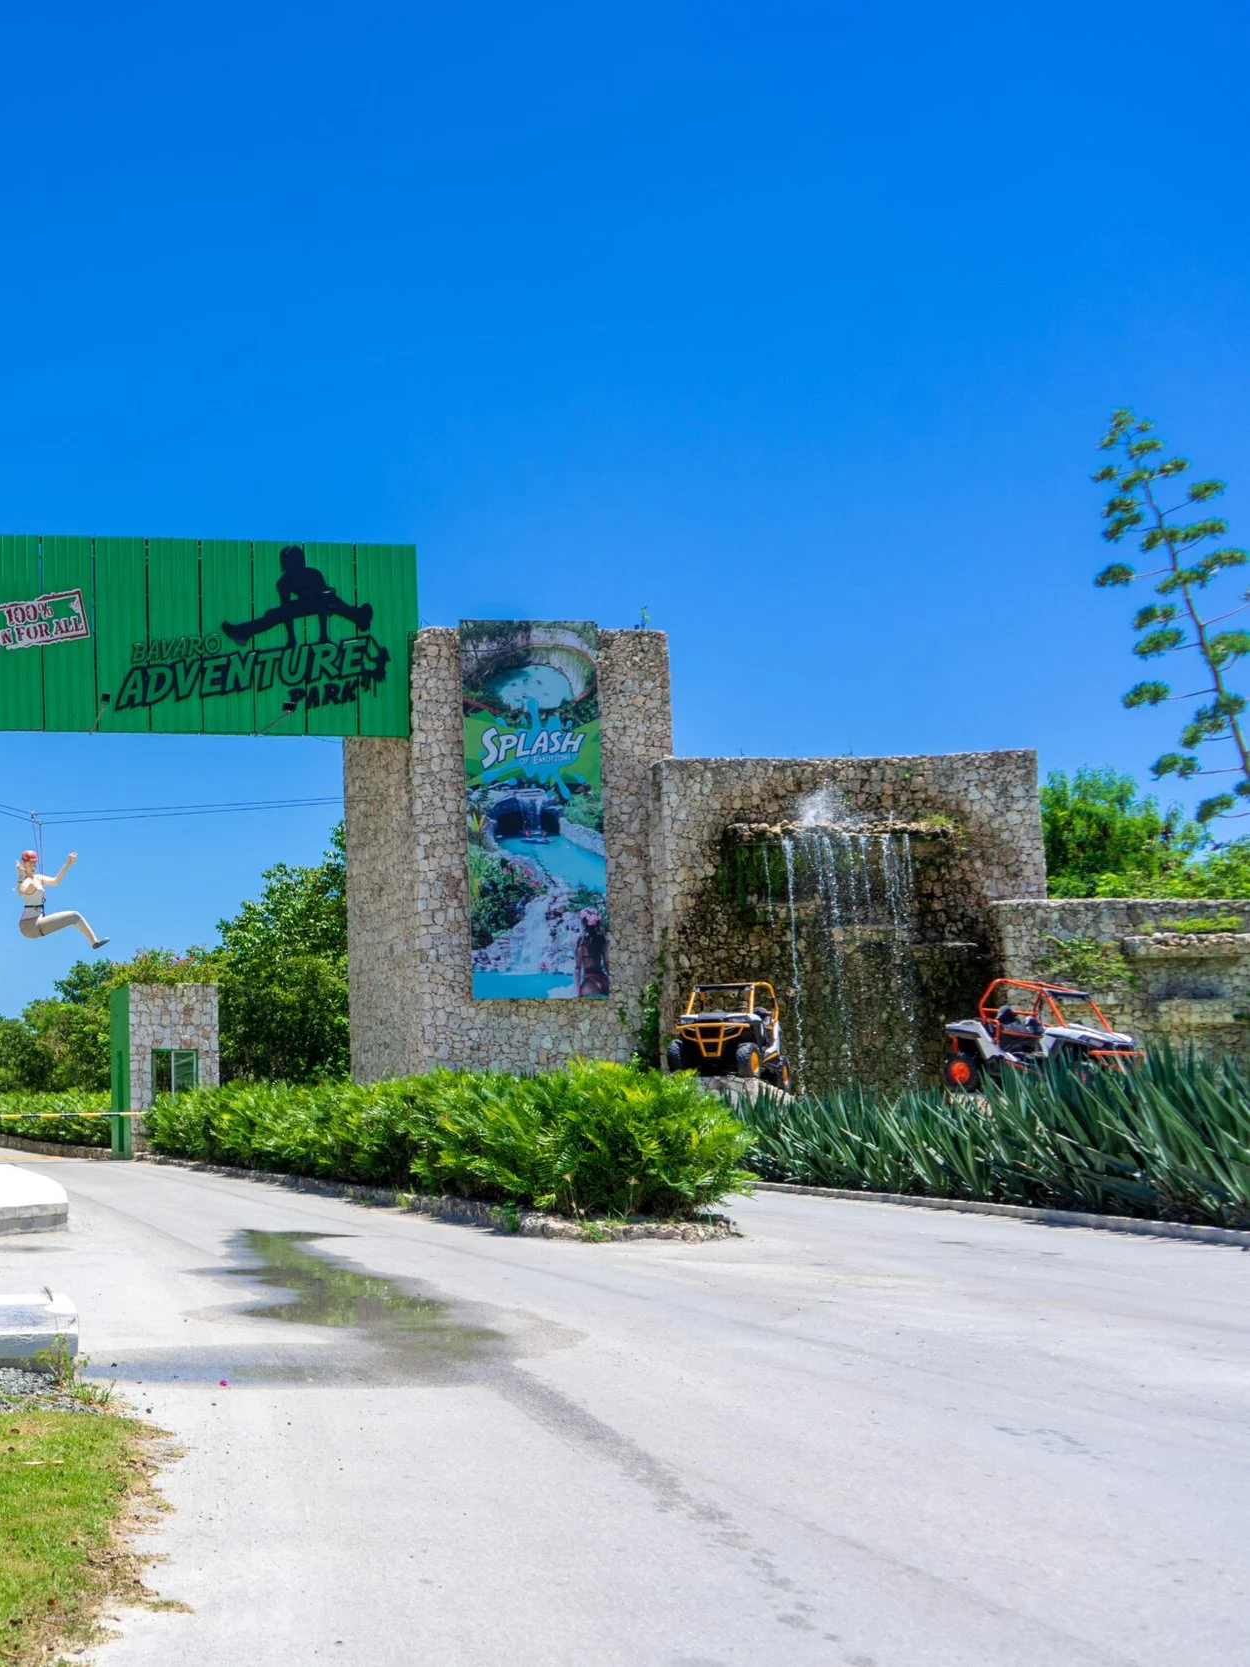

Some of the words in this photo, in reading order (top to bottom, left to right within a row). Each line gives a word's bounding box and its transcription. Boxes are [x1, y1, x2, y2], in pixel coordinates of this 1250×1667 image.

[6, 602, 54, 626] 100%
[15, 622, 50, 642] FOR
[53, 617, 84, 635] ALL
[131, 633, 223, 664] BAVARO
[114, 636, 371, 712] ADVENTURE
[289, 676, 360, 710] PARK
[481, 727, 586, 771] SPLASH
